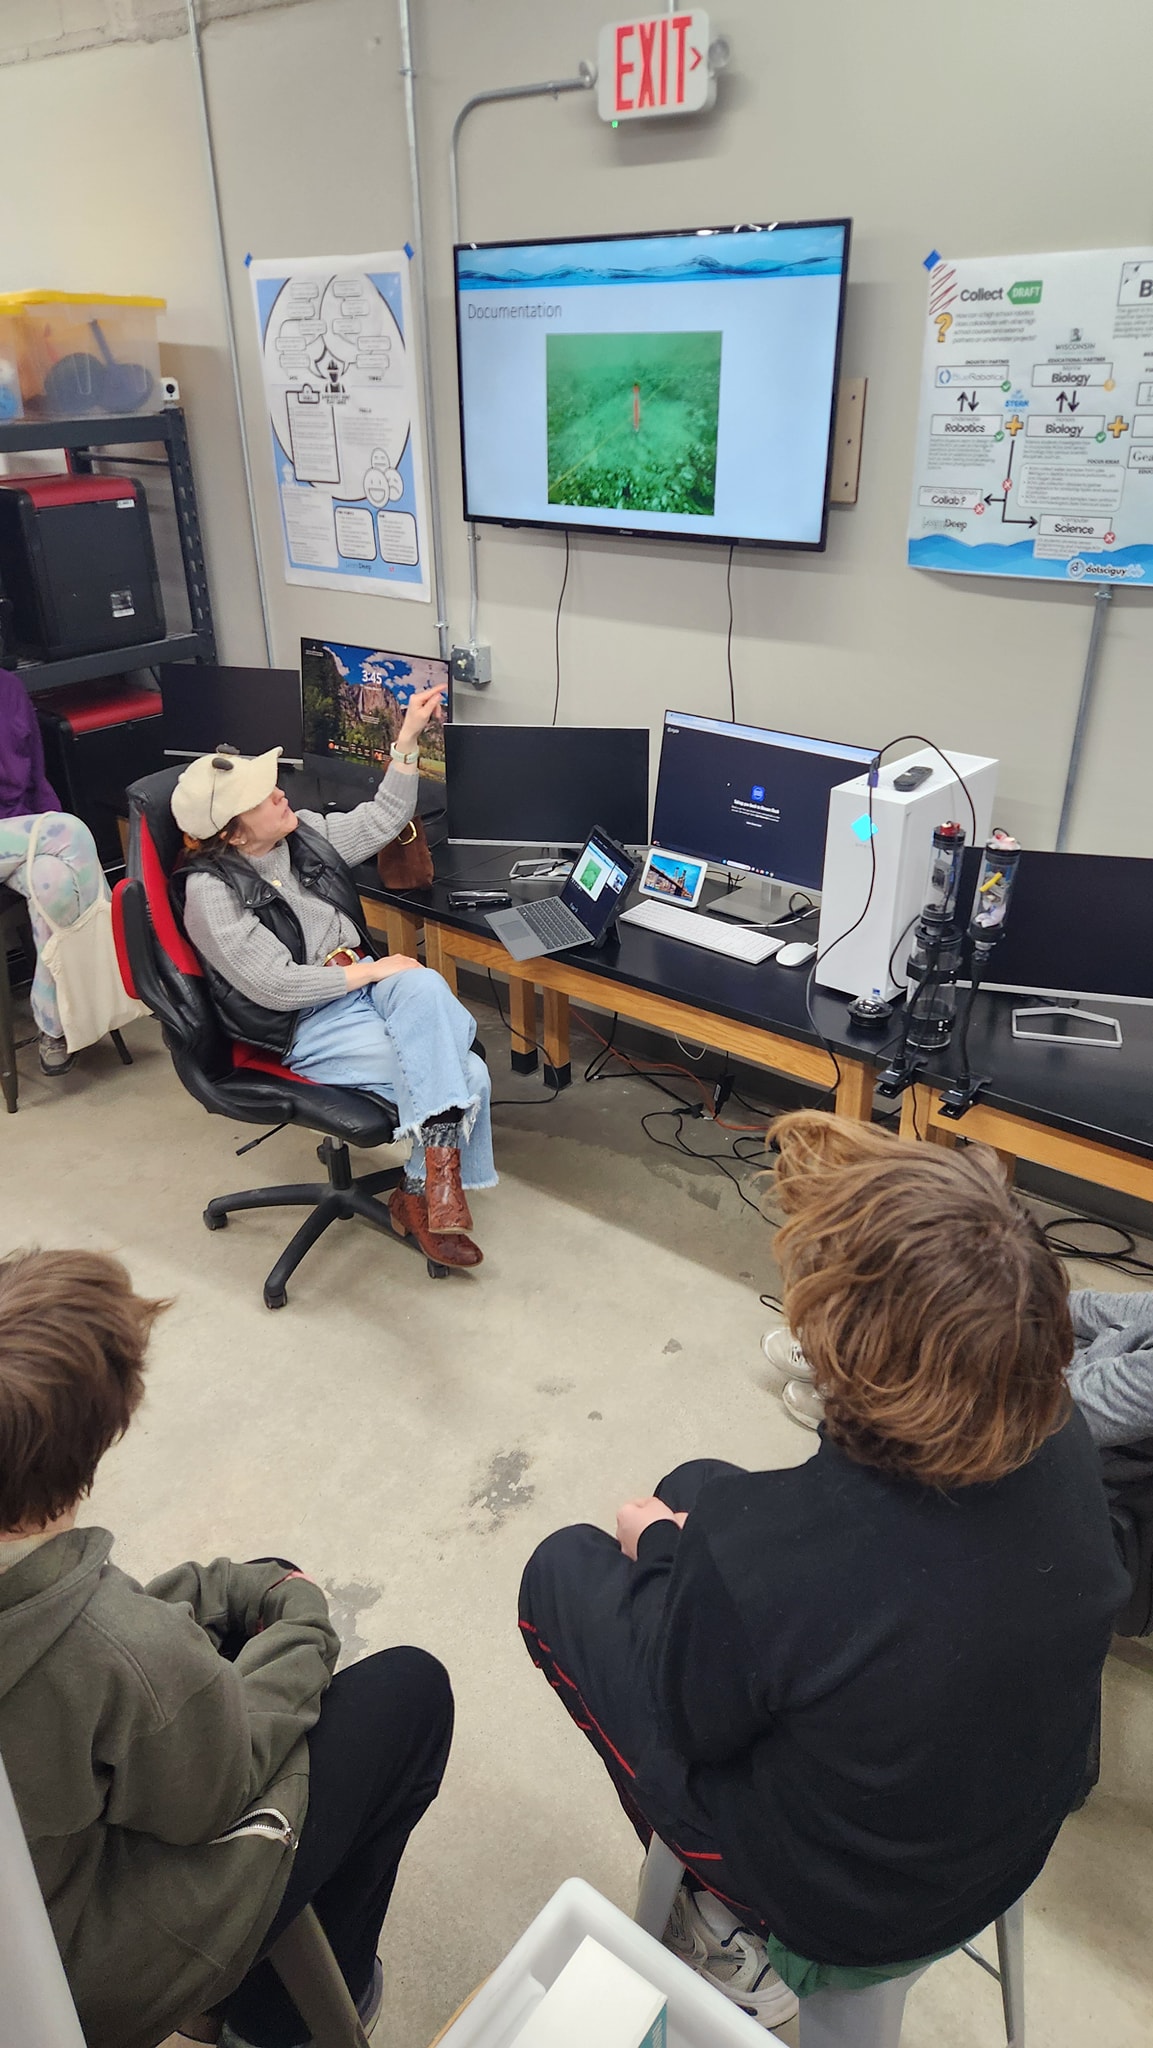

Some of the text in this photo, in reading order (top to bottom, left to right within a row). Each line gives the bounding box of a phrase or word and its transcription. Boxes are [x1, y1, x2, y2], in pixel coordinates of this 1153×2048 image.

[615, 15, 693, 112] EXIT
[960, 286, 1041, 302] Collect DRAFT
[467, 302, 562, 319] Documentation
[1052, 372, 1091, 387] Biology
[945, 422, 985, 433] Robotics
[1046, 423, 1084, 438] Biology
[931, 495, 960, 505] Collab
[1054, 523, 1094, 535] Science
[361, 670, 382, 684] 3:45
